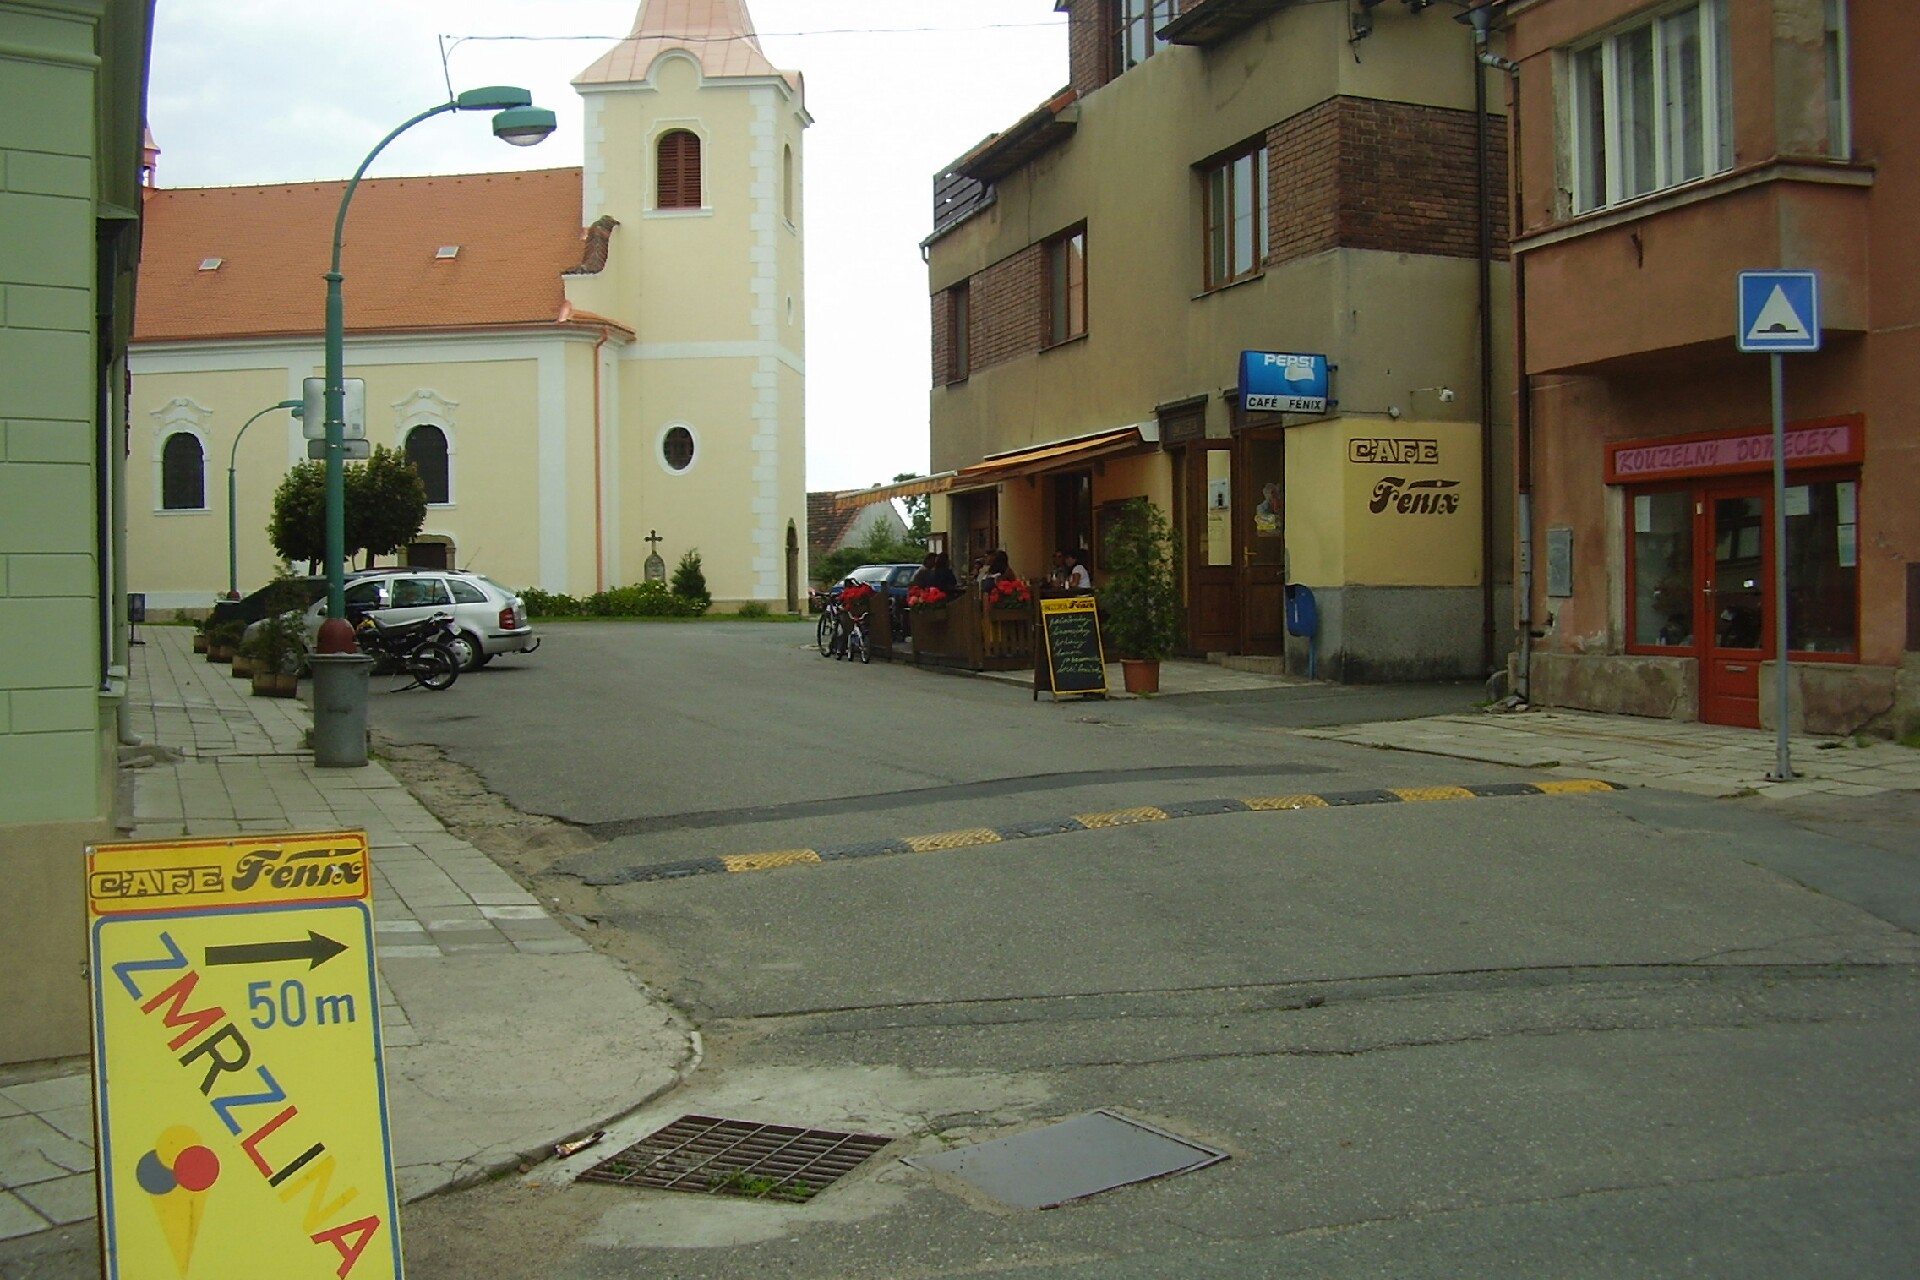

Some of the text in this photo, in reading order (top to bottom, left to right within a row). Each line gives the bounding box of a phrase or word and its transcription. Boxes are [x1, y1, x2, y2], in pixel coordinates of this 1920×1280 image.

[1263, 354, 1315, 369] PEPSI
[1348, 438, 1438, 464] CAFE
[1369, 476, 1460, 514] Fenix
[90, 848, 367, 899] CAFE Fenix
[112, 931, 381, 1280] ZMRZLINA
